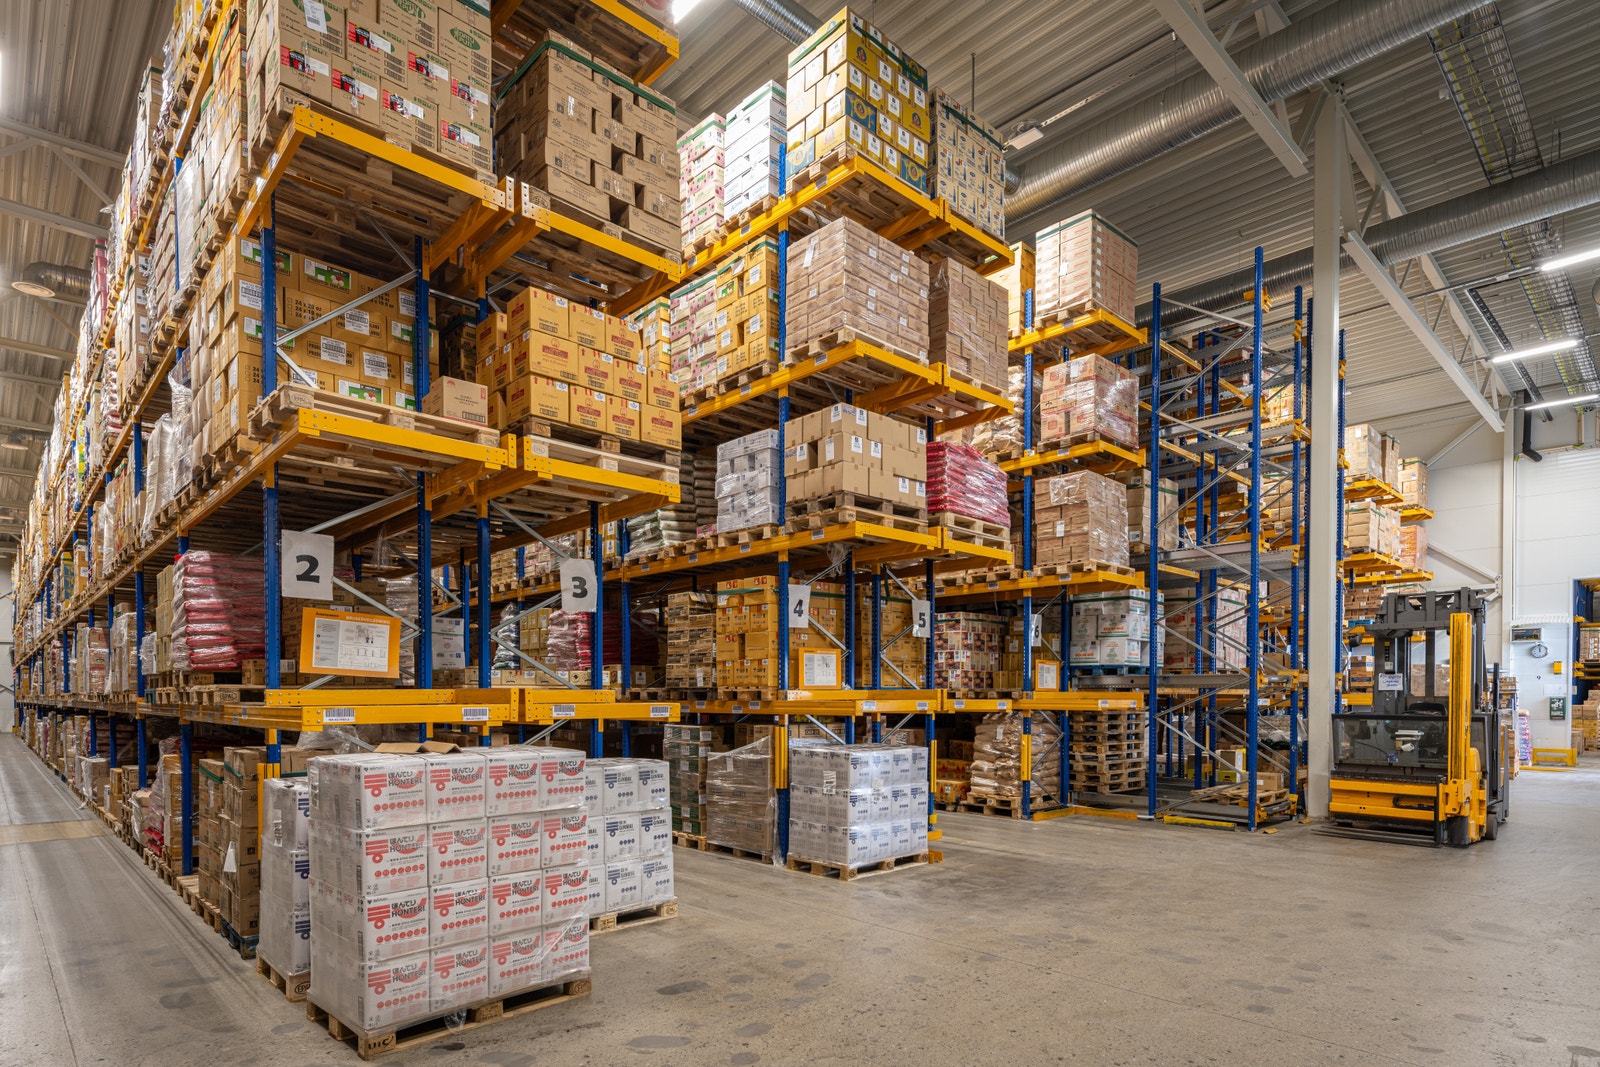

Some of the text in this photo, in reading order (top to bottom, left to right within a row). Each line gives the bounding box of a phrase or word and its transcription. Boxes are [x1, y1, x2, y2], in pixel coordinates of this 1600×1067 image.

[295, 554, 321, 583] 2
[571, 576, 588, 599] 3
[793, 599, 804, 618] 4
[918, 612, 926, 628] 5
[1034, 625, 1039, 638] 6
[508, 769, 536, 777] HONTERI
[559, 766, 584, 774] HONTERI
[388, 778, 422, 786] HONTERI
[452, 772, 482, 782] HONTERI
[563, 876, 587, 886] HONTERI
[512, 885, 539, 896] HONTERI
[456, 894, 486, 906] HONTERI
[392, 906, 425, 918] HONTERI
[392, 970, 426, 982] HONTERI
